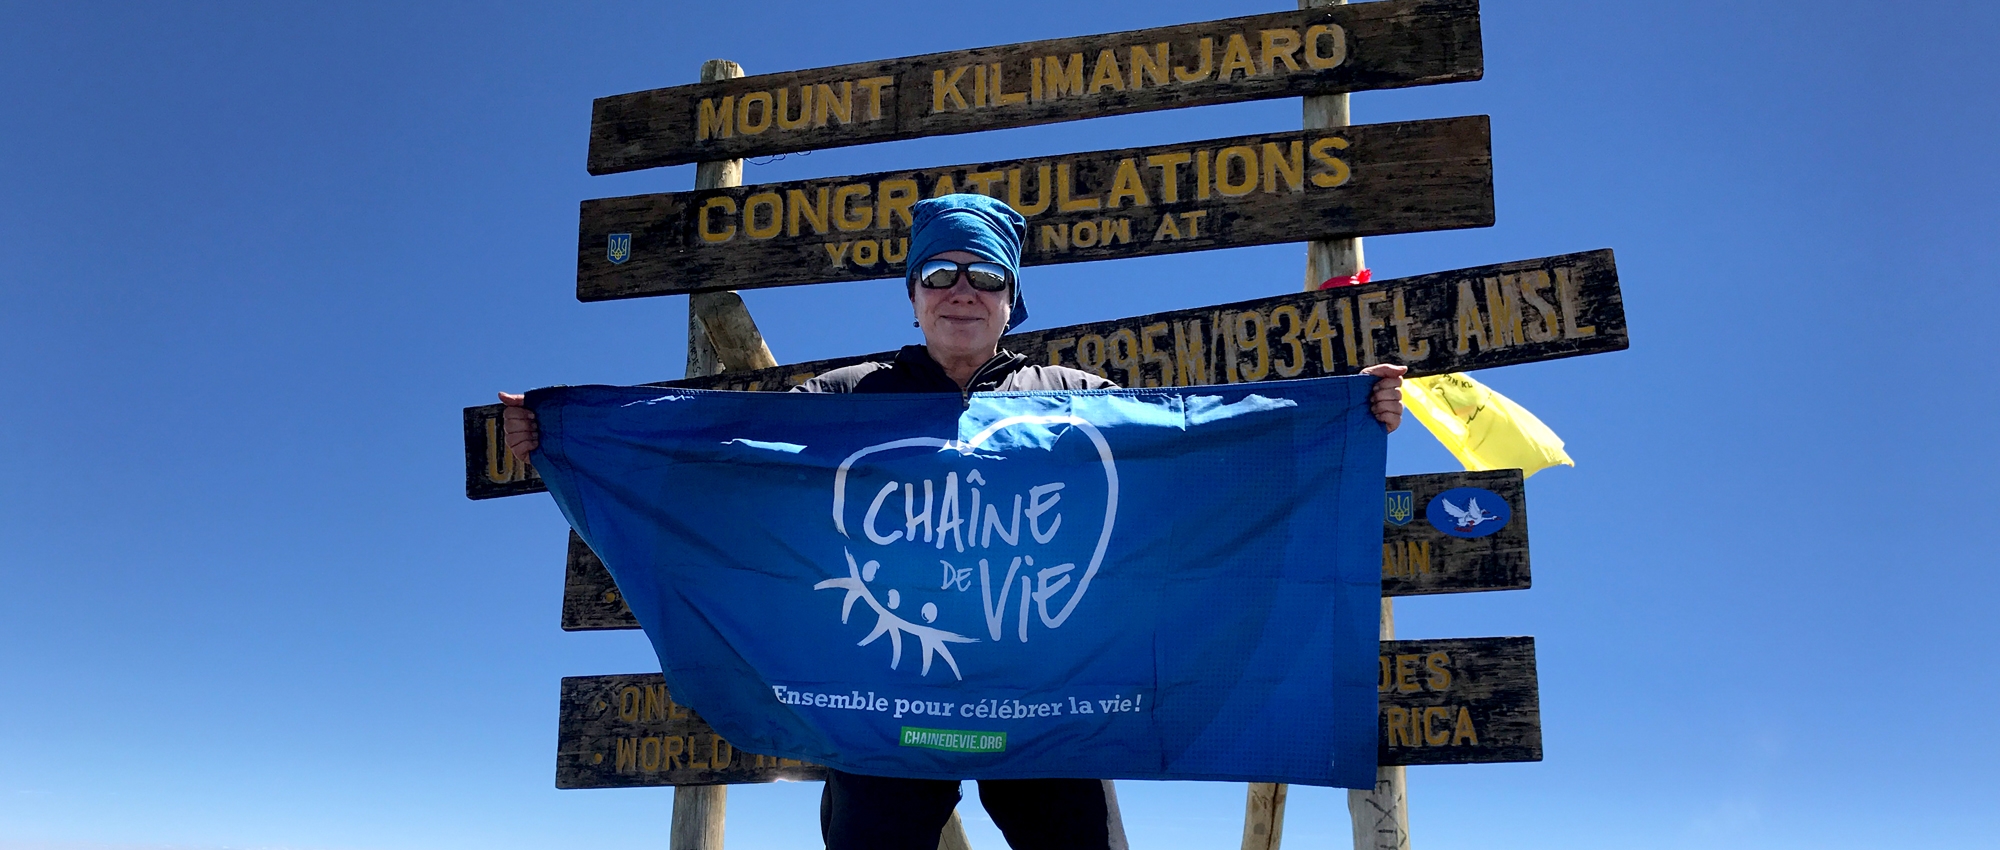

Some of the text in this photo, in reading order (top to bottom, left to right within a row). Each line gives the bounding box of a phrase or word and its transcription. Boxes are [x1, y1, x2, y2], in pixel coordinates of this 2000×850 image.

[699, 23, 1346, 141] MOUNT KILIMANJARO
[825, 210, 1207, 268] YOU NOW AT
[1456, 267, 1596, 355] AMSL
[863, 468, 1066, 553] CHAÎNE
[939, 559, 973, 592] DE
[772, 685, 1142, 719] Ensemble pour célébrer la vie!
[616, 733, 733, 773] WORLD
[904, 730, 1003, 750] CHAINEDEVIE.ORG
